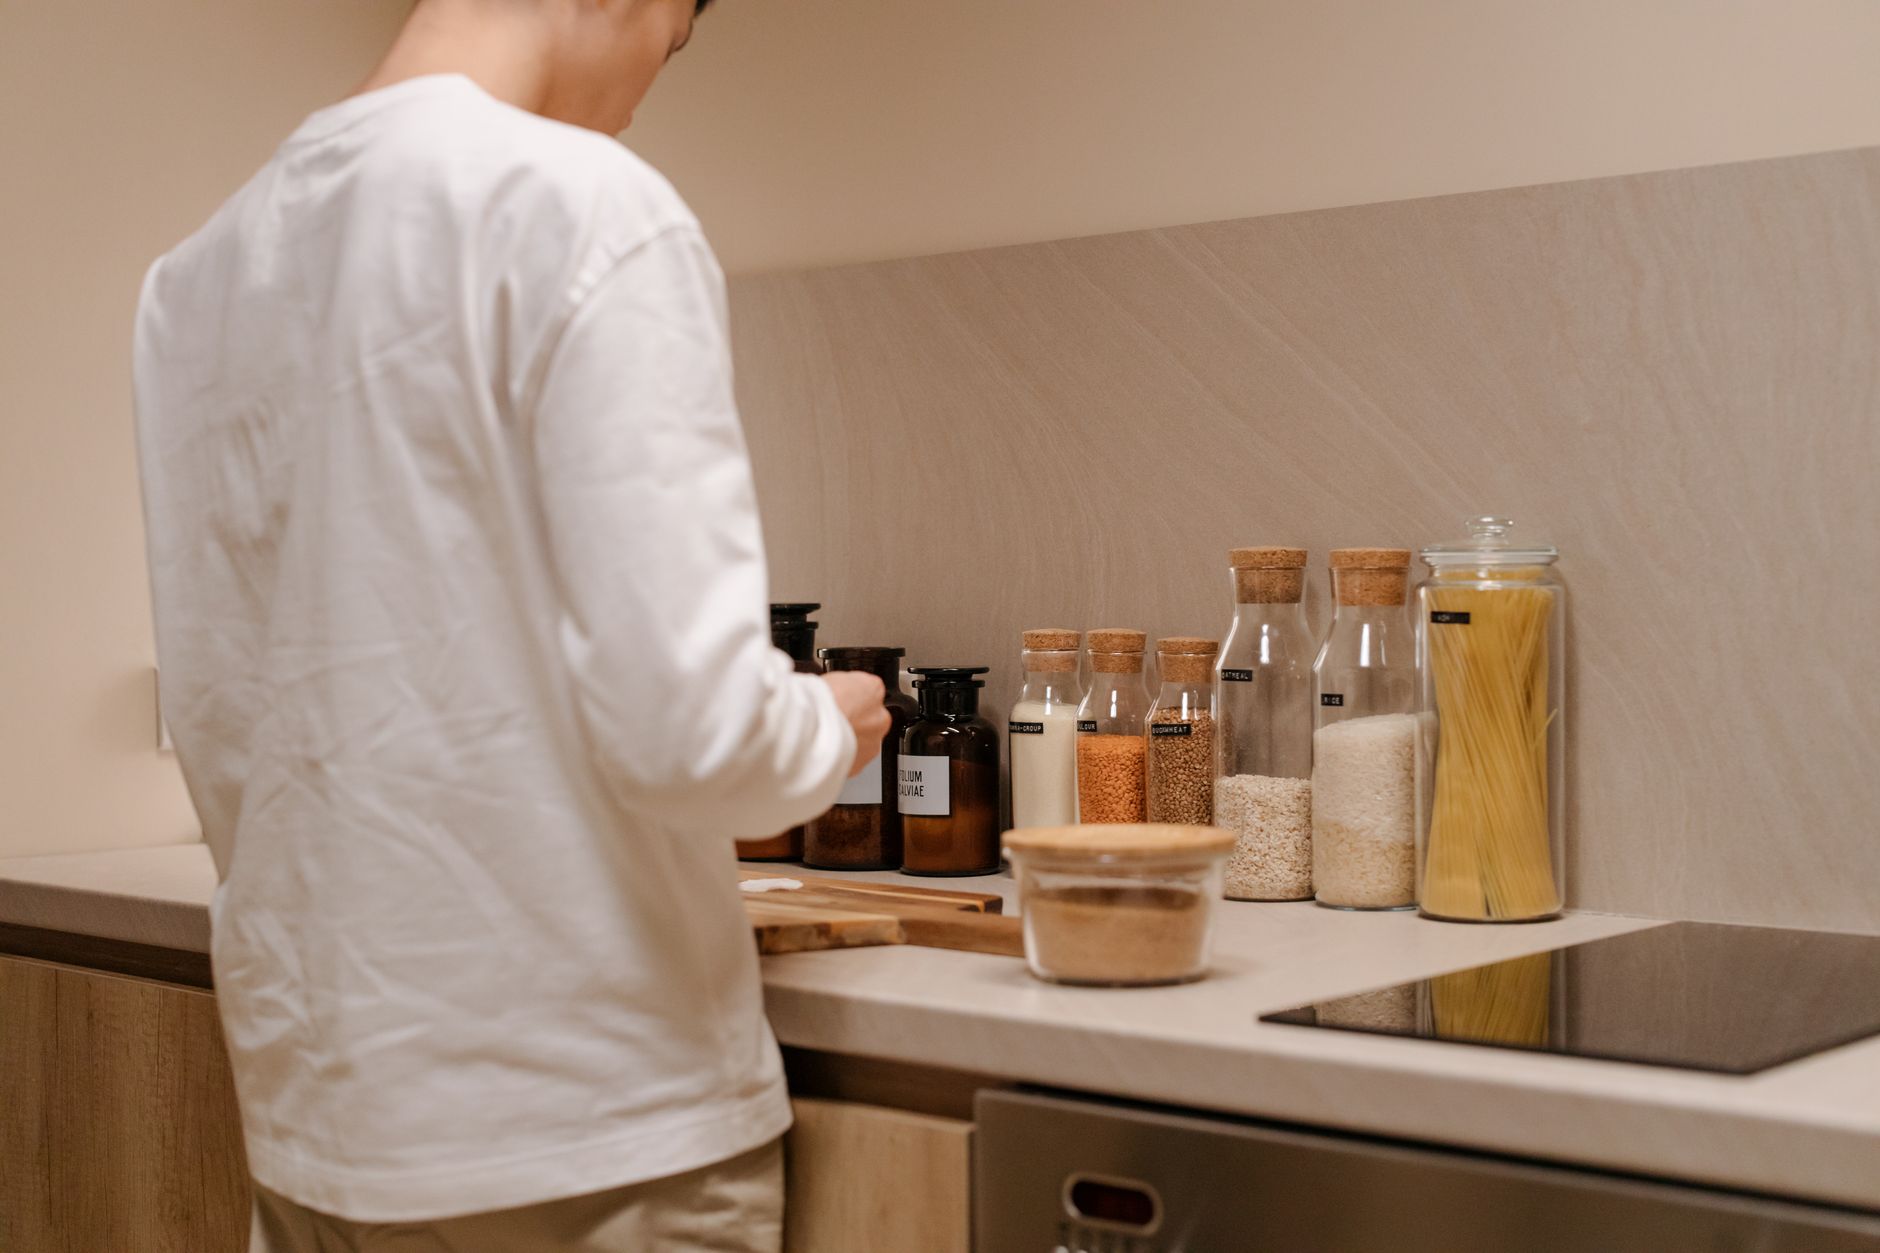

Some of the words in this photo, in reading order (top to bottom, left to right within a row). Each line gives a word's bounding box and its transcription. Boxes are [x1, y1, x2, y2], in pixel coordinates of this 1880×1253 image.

[1221, 671, 1249, 680] OATMEAL
[1323, 696, 1340, 704] RICE
[899, 769, 923, 782] FOLIUM
[898, 783, 925, 797] SALVIAE
